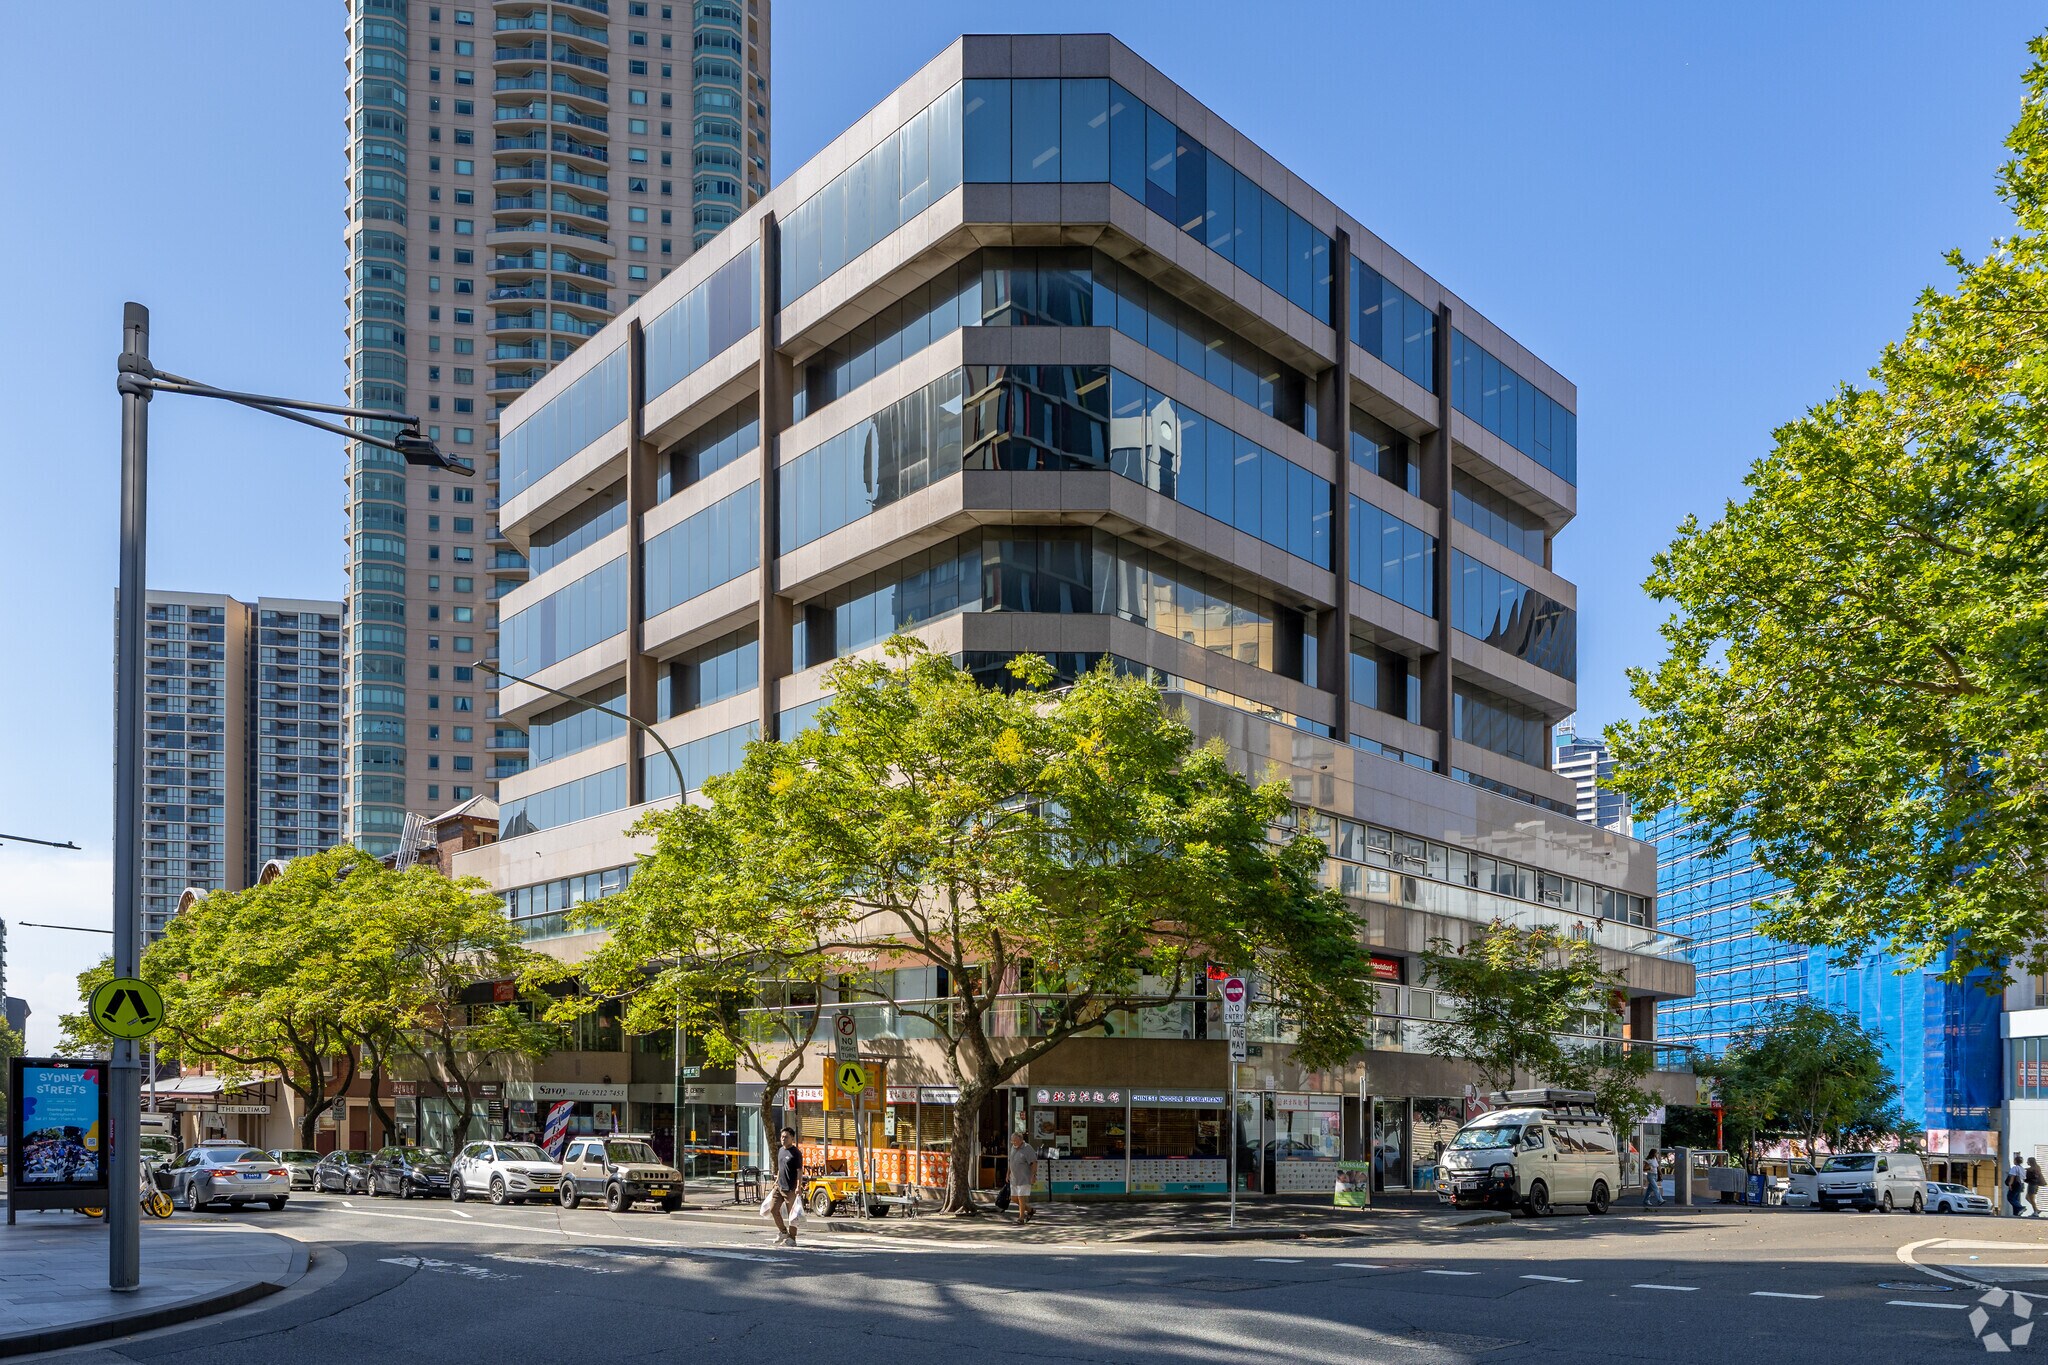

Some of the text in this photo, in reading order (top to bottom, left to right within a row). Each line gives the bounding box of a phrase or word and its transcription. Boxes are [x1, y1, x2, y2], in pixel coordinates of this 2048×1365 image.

[1229, 1004, 1240, 1012] NO
[1232, 1029, 1244, 1038] ONE
[841, 1037, 853, 1045] NO
[1231, 1041, 1245, 1050] WAY
[39, 1072, 84, 1083] SYDNEY
[36, 1083, 87, 1095] STREETS
[537, 1085, 567, 1096] Savoy
[1132, 1094, 1224, 1104] CHINESE NOODLE RESTAURANT
